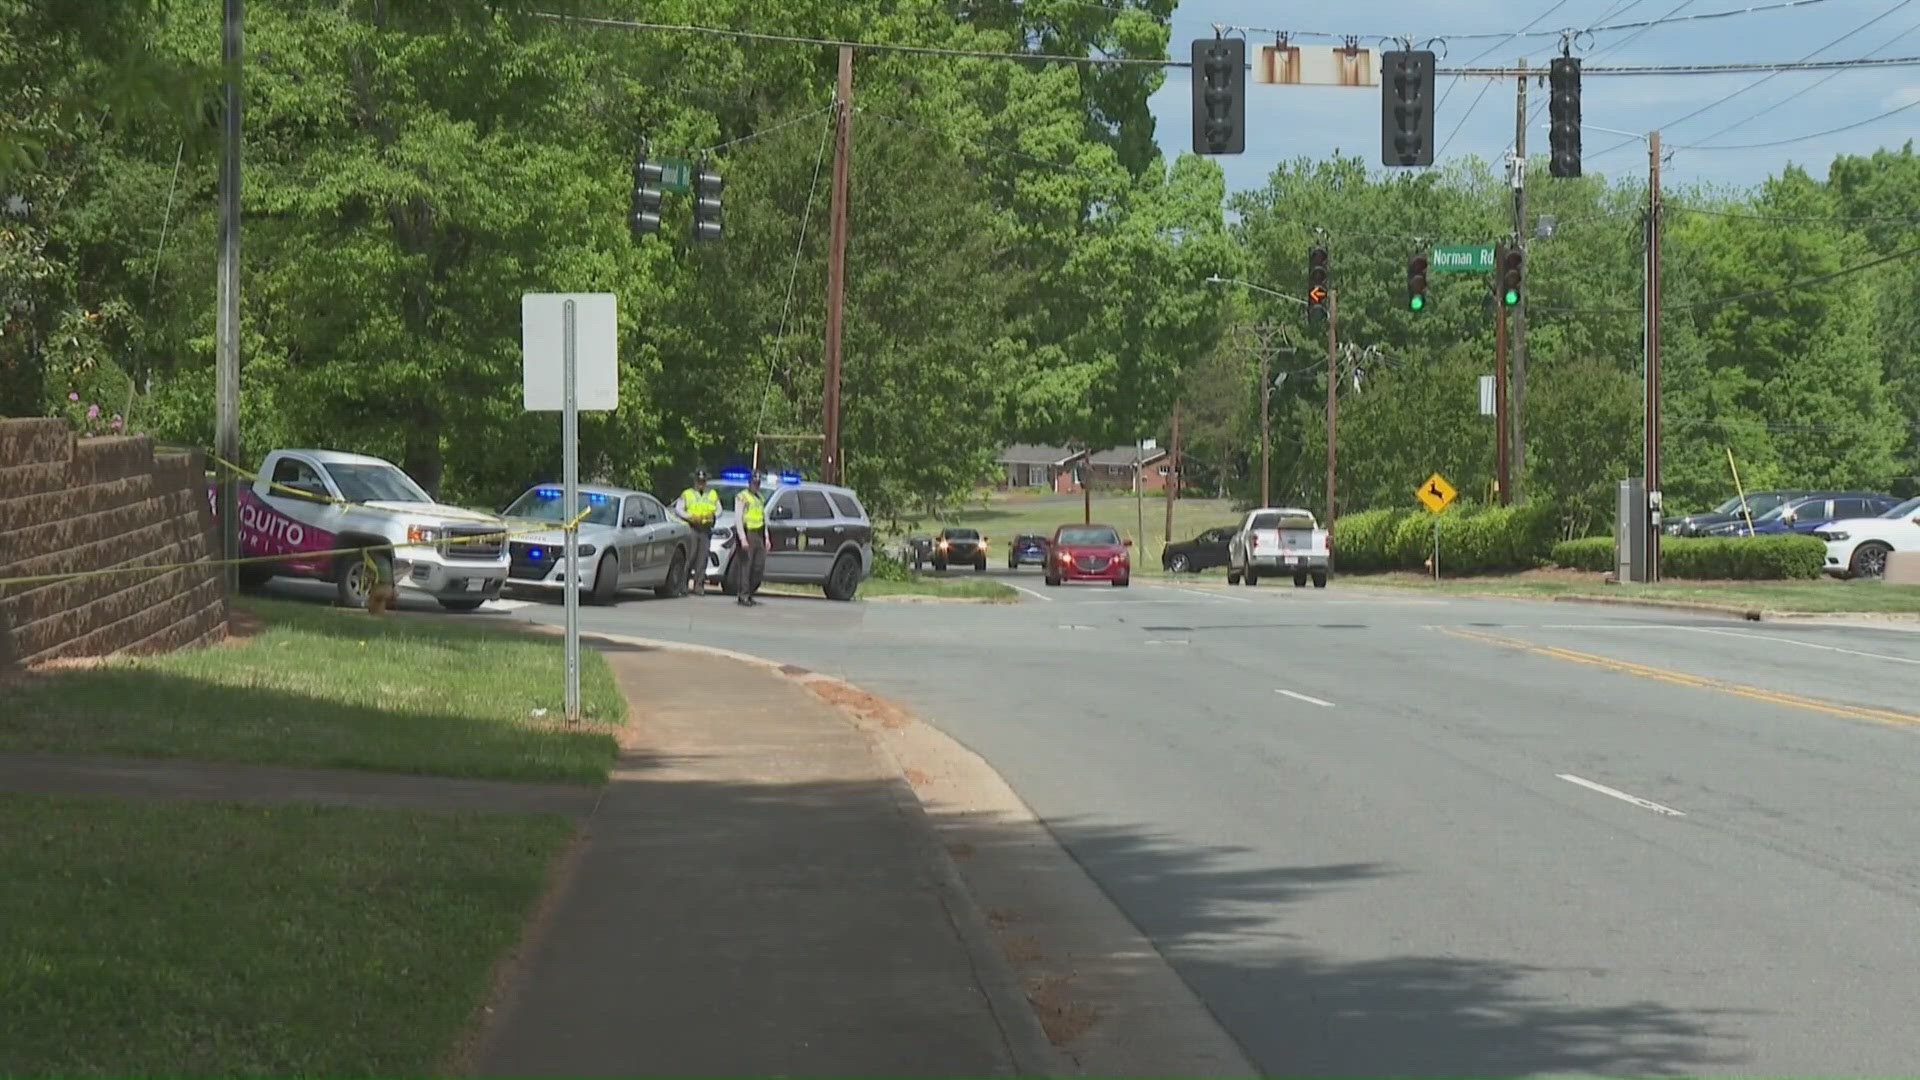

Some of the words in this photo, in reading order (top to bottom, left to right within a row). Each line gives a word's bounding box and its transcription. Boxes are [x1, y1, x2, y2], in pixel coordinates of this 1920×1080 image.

[1433, 248, 1472, 265] Norman
[1480, 248, 1495, 265] Rd
[238, 502, 304, 546] QUITO
